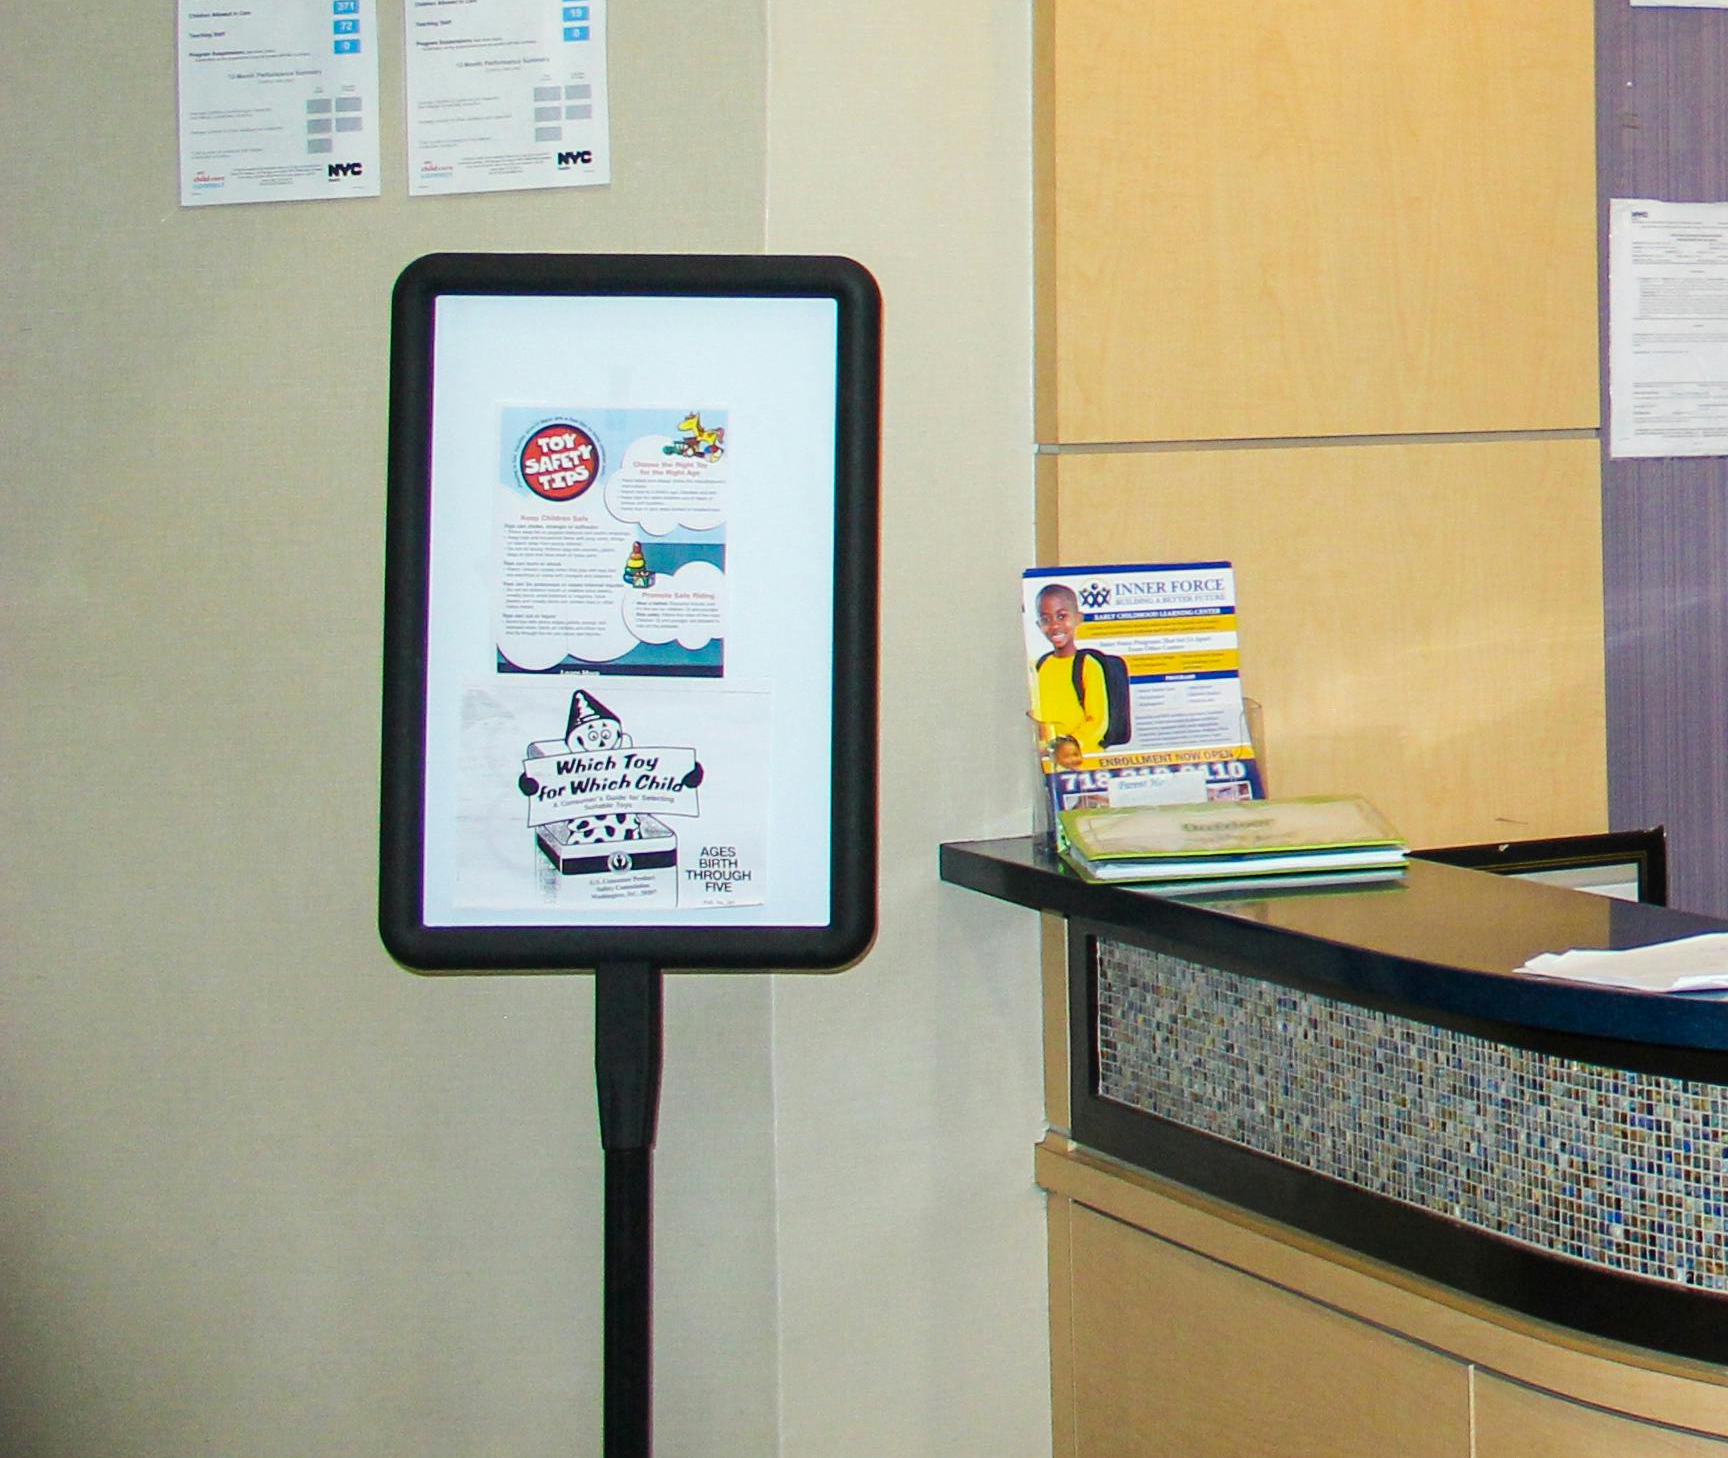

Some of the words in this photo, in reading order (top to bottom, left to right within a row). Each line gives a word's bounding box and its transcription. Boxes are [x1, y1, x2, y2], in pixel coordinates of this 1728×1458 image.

[557, 151, 592, 165] NYC
[327, 163, 362, 177] NYC
[537, 433, 577, 453] TOY
[525, 445, 593, 475] SAFETY
[538, 466, 590, 491] TIPS
[1115, 582, 1167, 595] INNER
[1171, 578, 1224, 593] FORCE
[1116, 597, 1155, 606] BUILDING
[1163, 595, 1193, 603] BETTER
[1117, 611, 1158, 619] CHILDHOOD
[556, 757, 617, 775] Which
[624, 754, 659, 771] Toy
[1099, 753, 1173, 767] ENROLLMENT
[1175, 752, 1201, 762] NOW
[1204, 750, 1234, 760] OPEN
[538, 785, 565, 802] for
[570, 775, 631, 792] Which
[634, 773, 684, 793] Child
[561, 796, 603, 808] Consumer's
[642, 794, 675, 803] Selecting
[701, 846, 736, 857] AGES
[699, 858, 738, 868] BIRTH
[686, 870, 752, 881] THROUGH
[705, 882, 732, 892] FIVE
